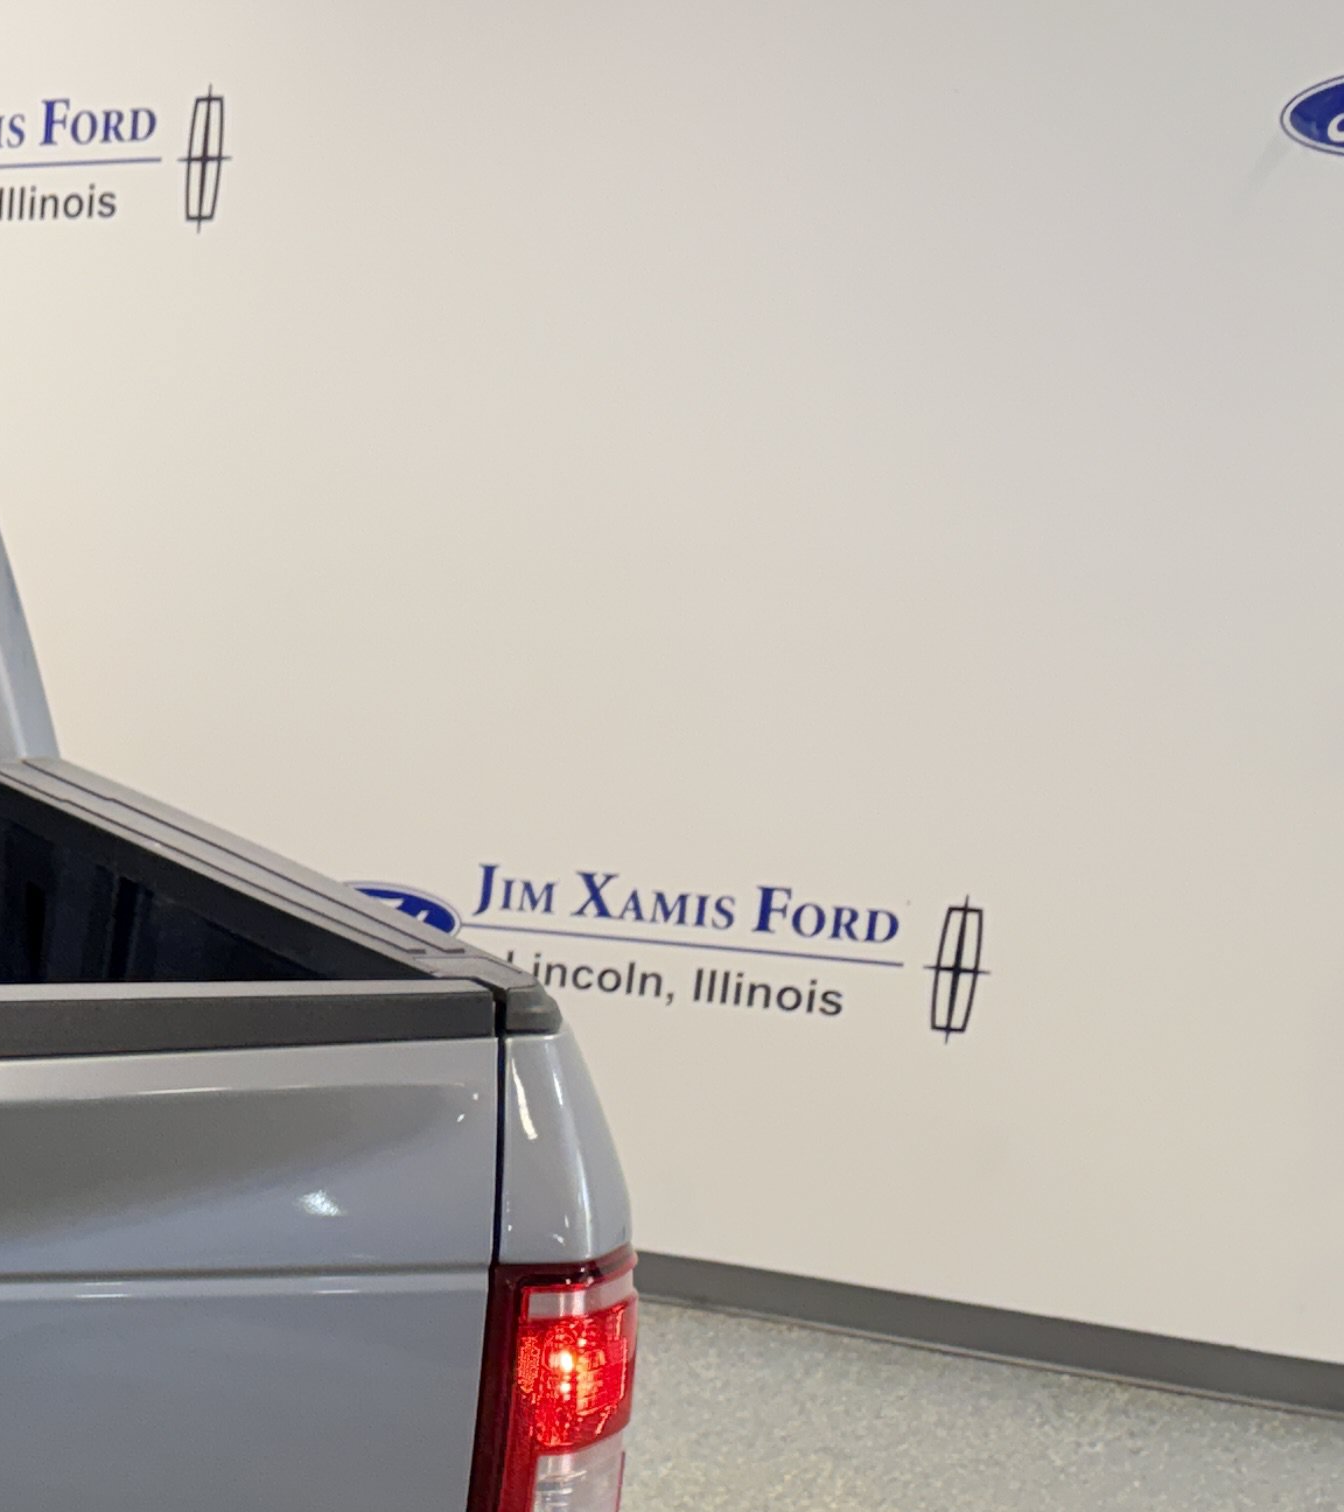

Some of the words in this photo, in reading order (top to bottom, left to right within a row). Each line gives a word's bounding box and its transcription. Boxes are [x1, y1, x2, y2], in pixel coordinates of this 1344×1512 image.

[39, 98, 157, 146] FORD
[471, 863, 558, 917] JIM
[570, 871, 736, 932] XAMIS
[753, 885, 900, 944] FORD
[507, 950, 675, 1006] incoln,
[693, 967, 844, 1017] Illinois
